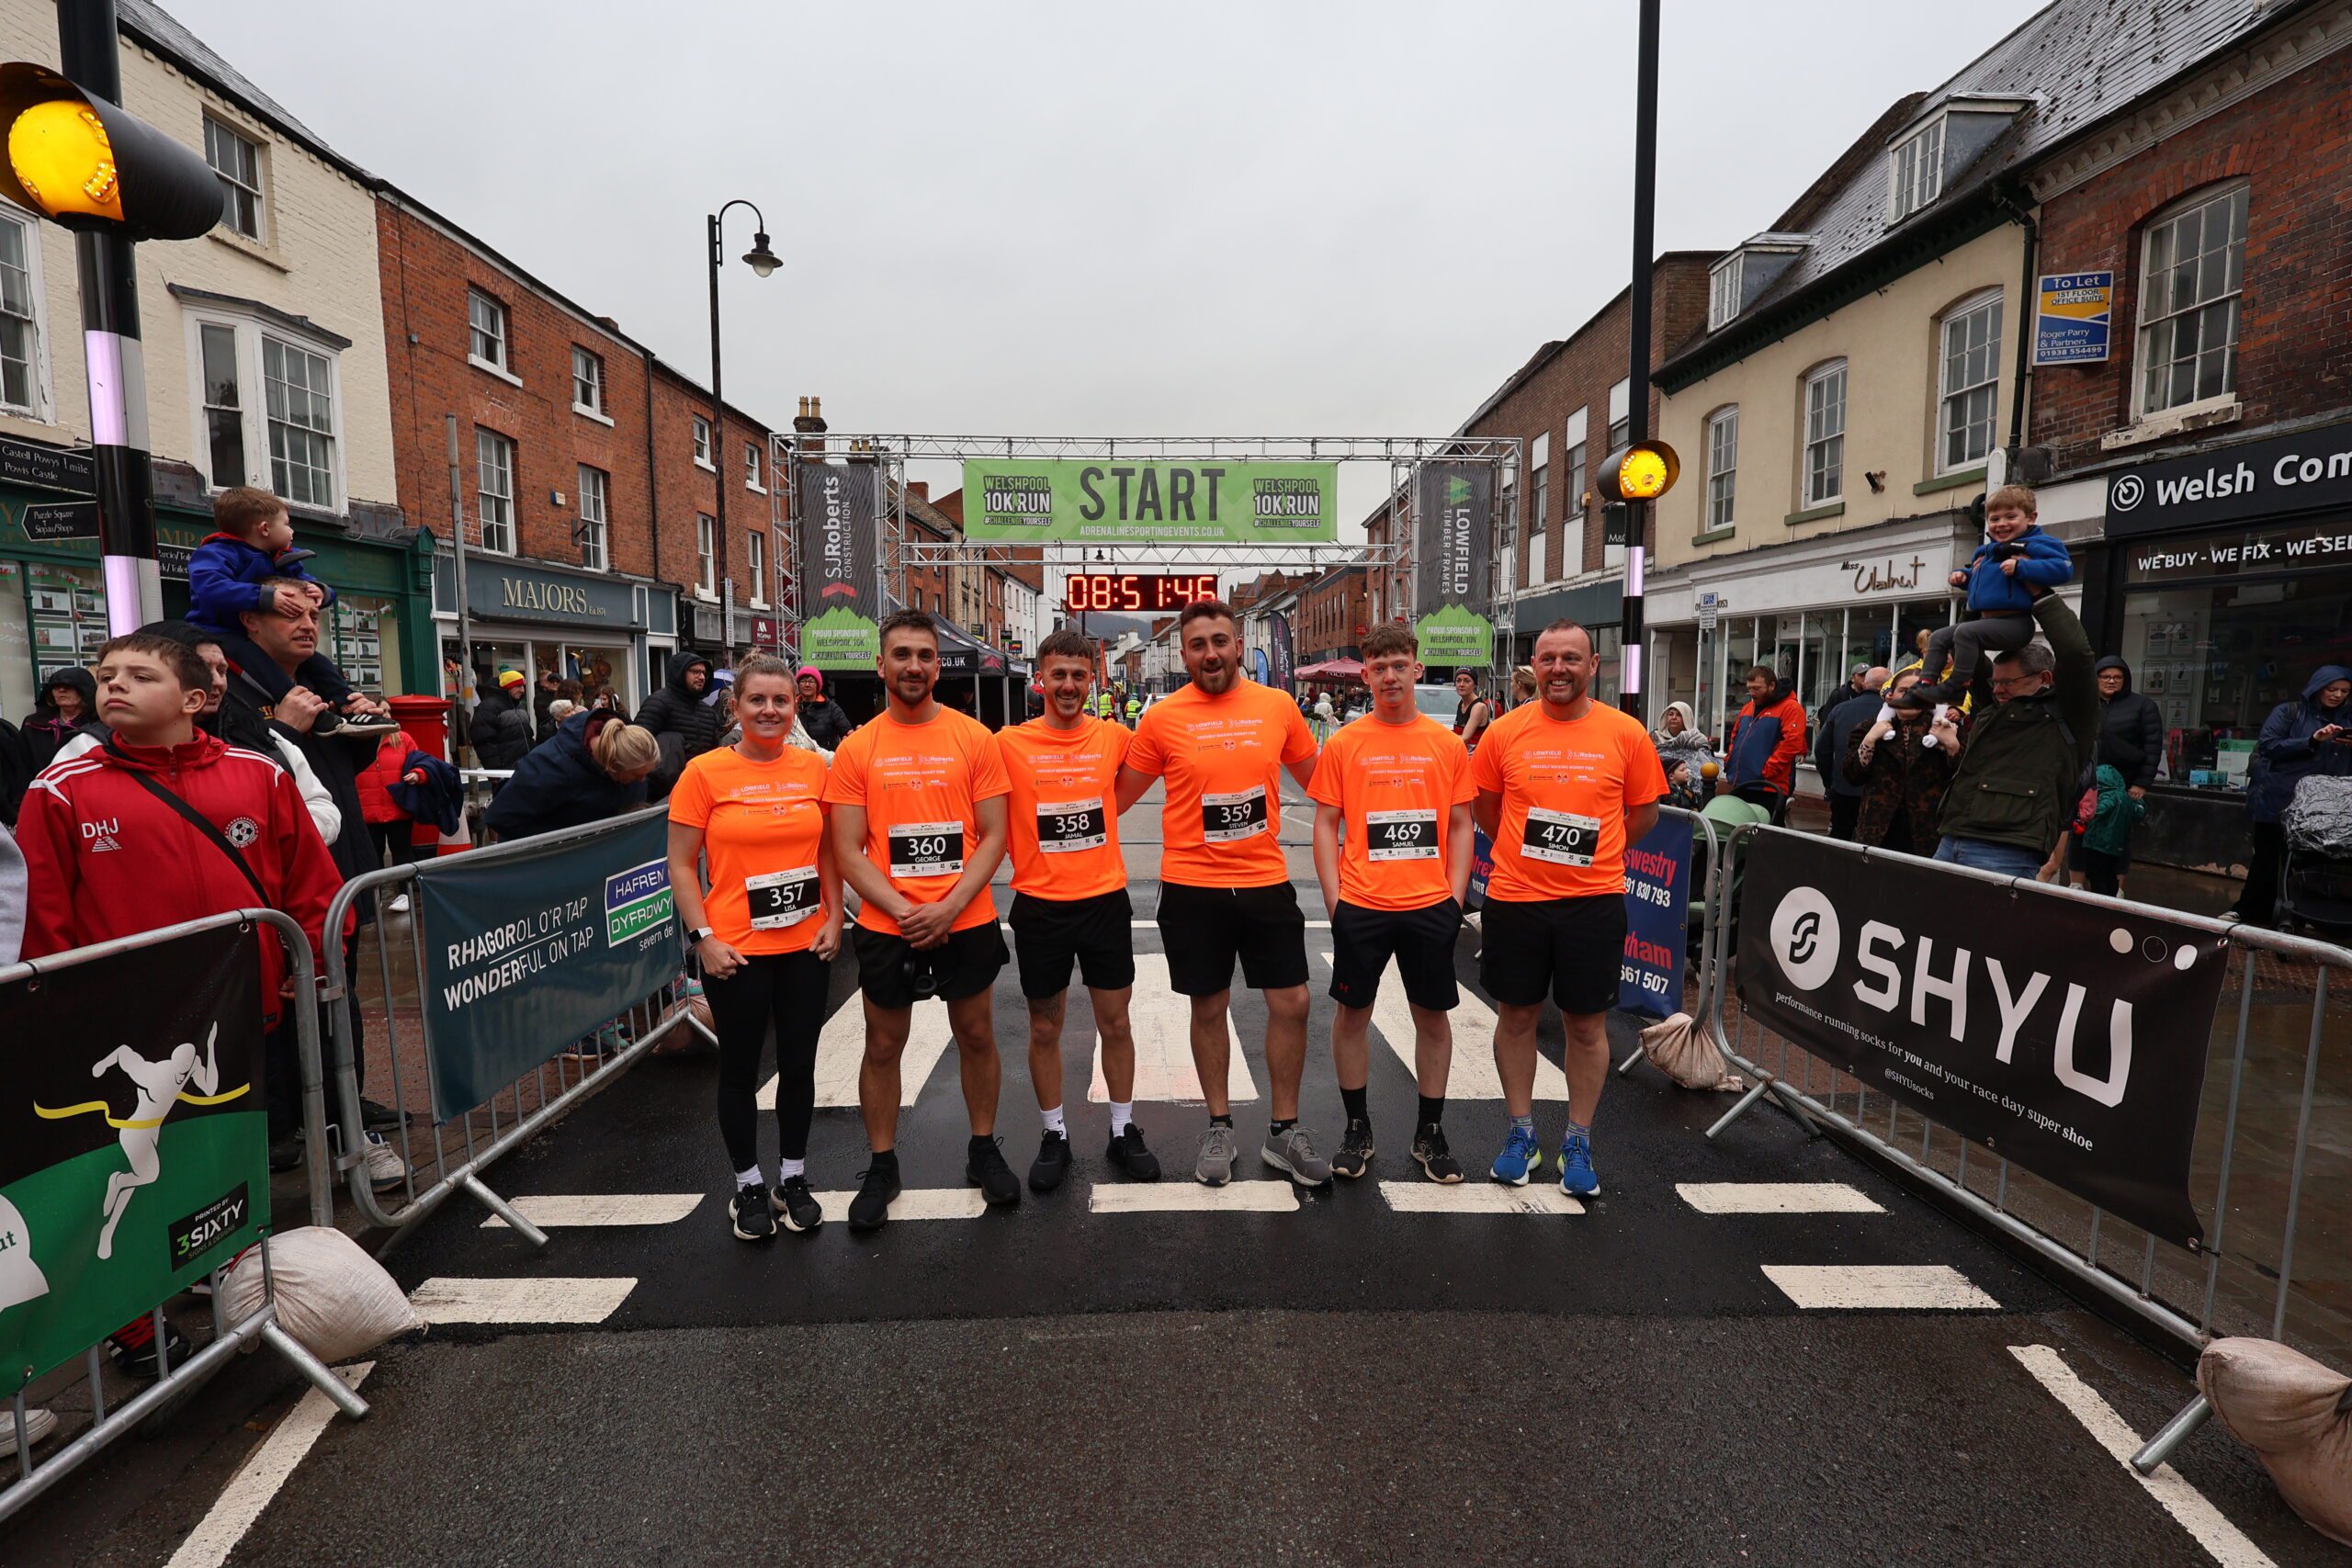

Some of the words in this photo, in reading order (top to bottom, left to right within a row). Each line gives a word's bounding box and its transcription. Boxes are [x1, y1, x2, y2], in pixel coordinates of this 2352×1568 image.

[2053, 278, 2071, 288] To
[2077, 276, 2099, 287] Let
[2041, 331, 2066, 340] Roger
[2068, 329, 2089, 337] Parry
[2051, 339, 2086, 347] Partners
[2070, 346, 2102, 355] 554499
[2, 446, 30, 460] Castell
[34, 453, 60, 468] Powys
[5, 461, 29, 474] Powis
[32, 467, 58, 480] Castle
[984, 476, 1050, 491] WELSHPOOL
[1080, 467, 1226, 521] START
[1254, 479, 1319, 493] WELSHPOOL
[2156, 462, 2256, 506] Welsh
[984, 491, 1013, 512] 10K
[1017, 492, 1050, 513] RUN
[1254, 494, 1283, 514] 10K
[1286, 495, 1319, 514] RUN
[34, 511, 52, 519] Puzzle
[53, 510, 74, 521] Square
[823, 477, 842, 579] SJRoberts
[1080, 525, 1225, 536] ADRENALINESPORTINGEVENTS.CO.UK
[1442, 509, 1452, 548] TIMBER
[842, 502, 853, 579] CONSTRUCTION
[1455, 508, 1470, 594] LOWFIELD
[2138, 555, 2161, 570] WE
[2165, 552, 2198, 568] BUY
[2211, 547, 2237, 563] WE
[2242, 544, 2270, 560] FIX
[2286, 539, 2316, 556] WE
[1442, 552, 1451, 594] FRAMES
[502, 577, 587, 615] MAJORS
[812, 629, 831, 637] PROUD
[833, 629, 859, 637] SPONSOR
[861, 629, 868, 637] OF
[1426, 626, 1445, 634] PROUD
[1446, 626, 1473, 634] SPONSOR
[1474, 626, 1482, 634] OF
[817, 638, 851, 647] WELSHPOOL
[1056, 814, 1090, 833] 358
[1221, 803, 1251, 823] 359
[82, 818, 119, 838] DHJ
[1384, 823, 1421, 840] 469
[1542, 825, 1580, 846] 470
[908, 837, 946, 856] 360
[1548, 842, 1569, 852] SIMON
[1623, 848, 1677, 887] swestry
[616, 868, 664, 899] HAFREN
[1636, 881, 1651, 901] 830
[1652, 886, 1670, 908] 793
[770, 883, 804, 907] 357
[611, 896, 672, 934] DYFRDWY
[447, 919, 536, 970] RHAGOROL
[539, 905, 561, 933] O'R
[565, 897, 588, 923] TAP
[639, 932, 662, 952] severn
[443, 947, 546, 1011] WONDERFUL
[549, 936, 568, 964] ON
[571, 926, 594, 953] TAP
[1643, 972, 1668, 994] 507
[1853, 919, 2133, 1108] SHYU
[1776, 991, 1822, 1021] performance
[1824, 1014, 1860, 1040] running
[1860, 1030, 1886, 1050] socks
[1888, 1042, 1904, 1056] for
[1905, 1050, 1922, 1067] you
[1924, 1060, 1943, 1078] and
[1944, 1071, 1971, 1090] your
[1973, 1086, 1998, 1103] race
[2001, 1093, 2025, 1118] day
[2028, 1108, 2061, 1134] super
[2063, 1126, 2094, 1151] shoe
[1884, 1067, 1934, 1100] @SHYUsocks
[195, 1202, 221, 1222] PRINTED
[221, 1198, 229, 1206] BY
[177, 1199, 243, 1256] 3SIXTY
[188, 1242, 207, 1258] SIGNS
[212, 1224, 235, 1243] DESIGNS
